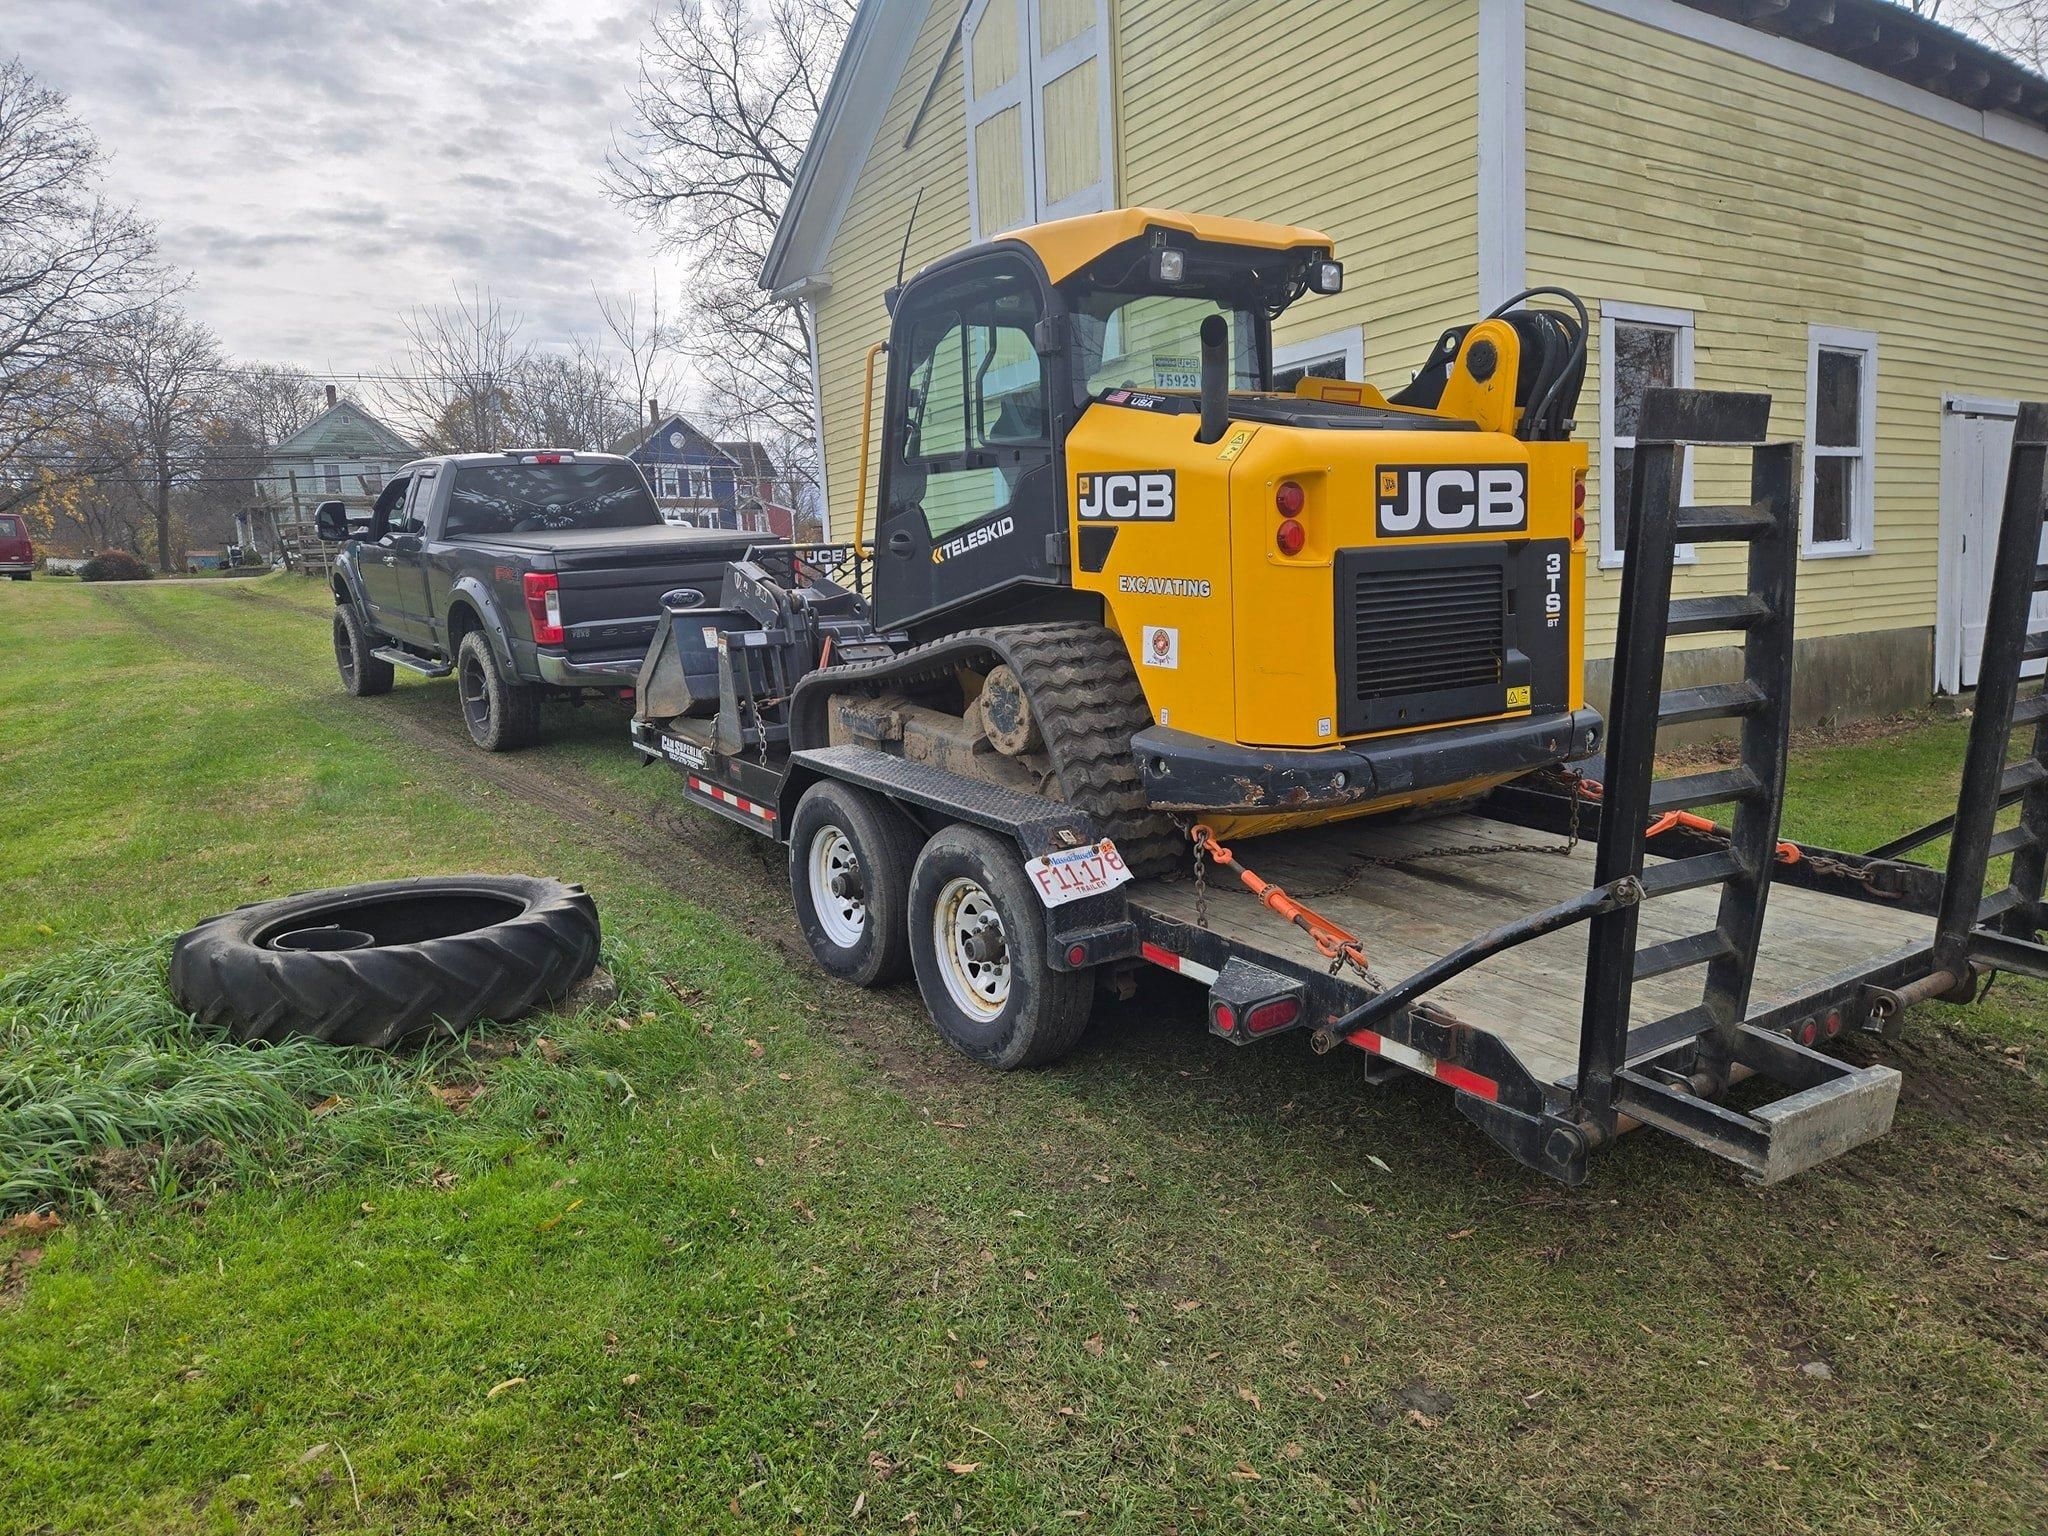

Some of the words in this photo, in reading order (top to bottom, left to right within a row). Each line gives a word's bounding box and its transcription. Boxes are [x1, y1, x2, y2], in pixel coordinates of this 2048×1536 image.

[1158, 373, 1196, 387] 75929
[1130, 397, 1154, 408] USA
[1080, 474, 1173, 517] JCB
[1380, 470, 1525, 531] JCB
[943, 516, 1014, 559] TELESKID
[806, 549, 845, 564] JCB
[1119, 575, 1211, 597] EXCAVATING
[1050, 850, 1096, 866] Massachusett
[1076, 880, 1108, 894] TRAILER
